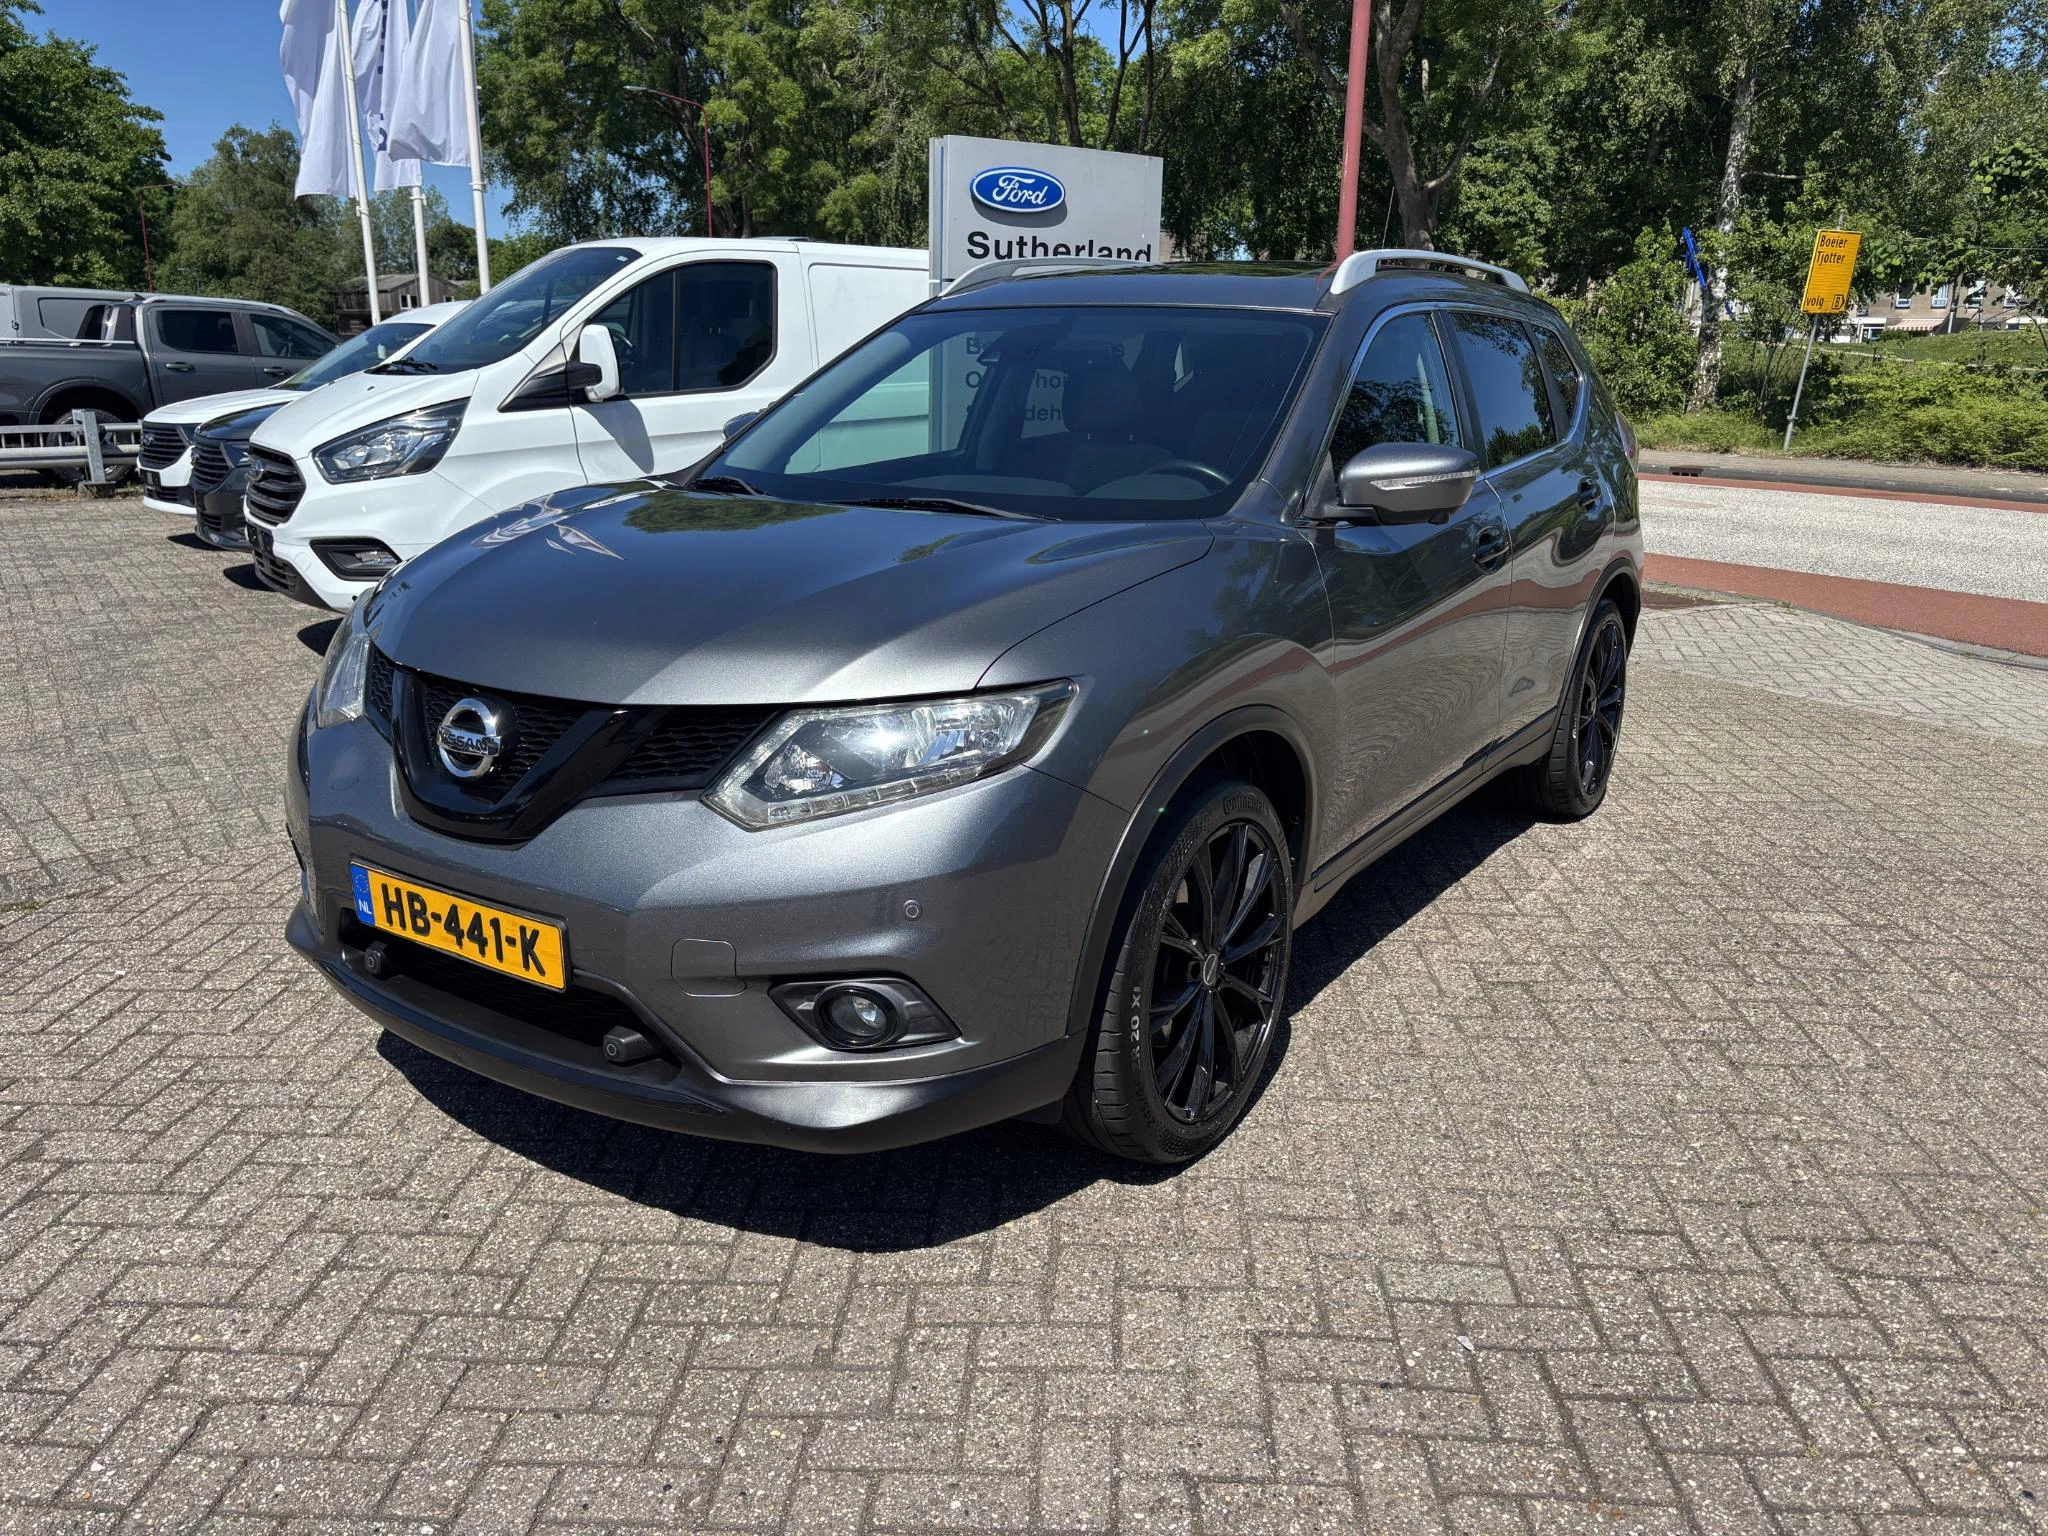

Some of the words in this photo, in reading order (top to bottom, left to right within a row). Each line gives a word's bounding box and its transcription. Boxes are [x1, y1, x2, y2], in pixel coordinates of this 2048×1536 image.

[992, 174, 1047, 206] Ford
[967, 231, 1152, 263] Sutherland
[1819, 235, 1848, 248] Boeier
[1816, 251, 1845, 266] Tjotter
[1806, 296, 1824, 309] volg
[439, 727, 491, 753] NISSAN
[358, 899, 373, 915] NL
[381, 882, 547, 977] HB-441-K
